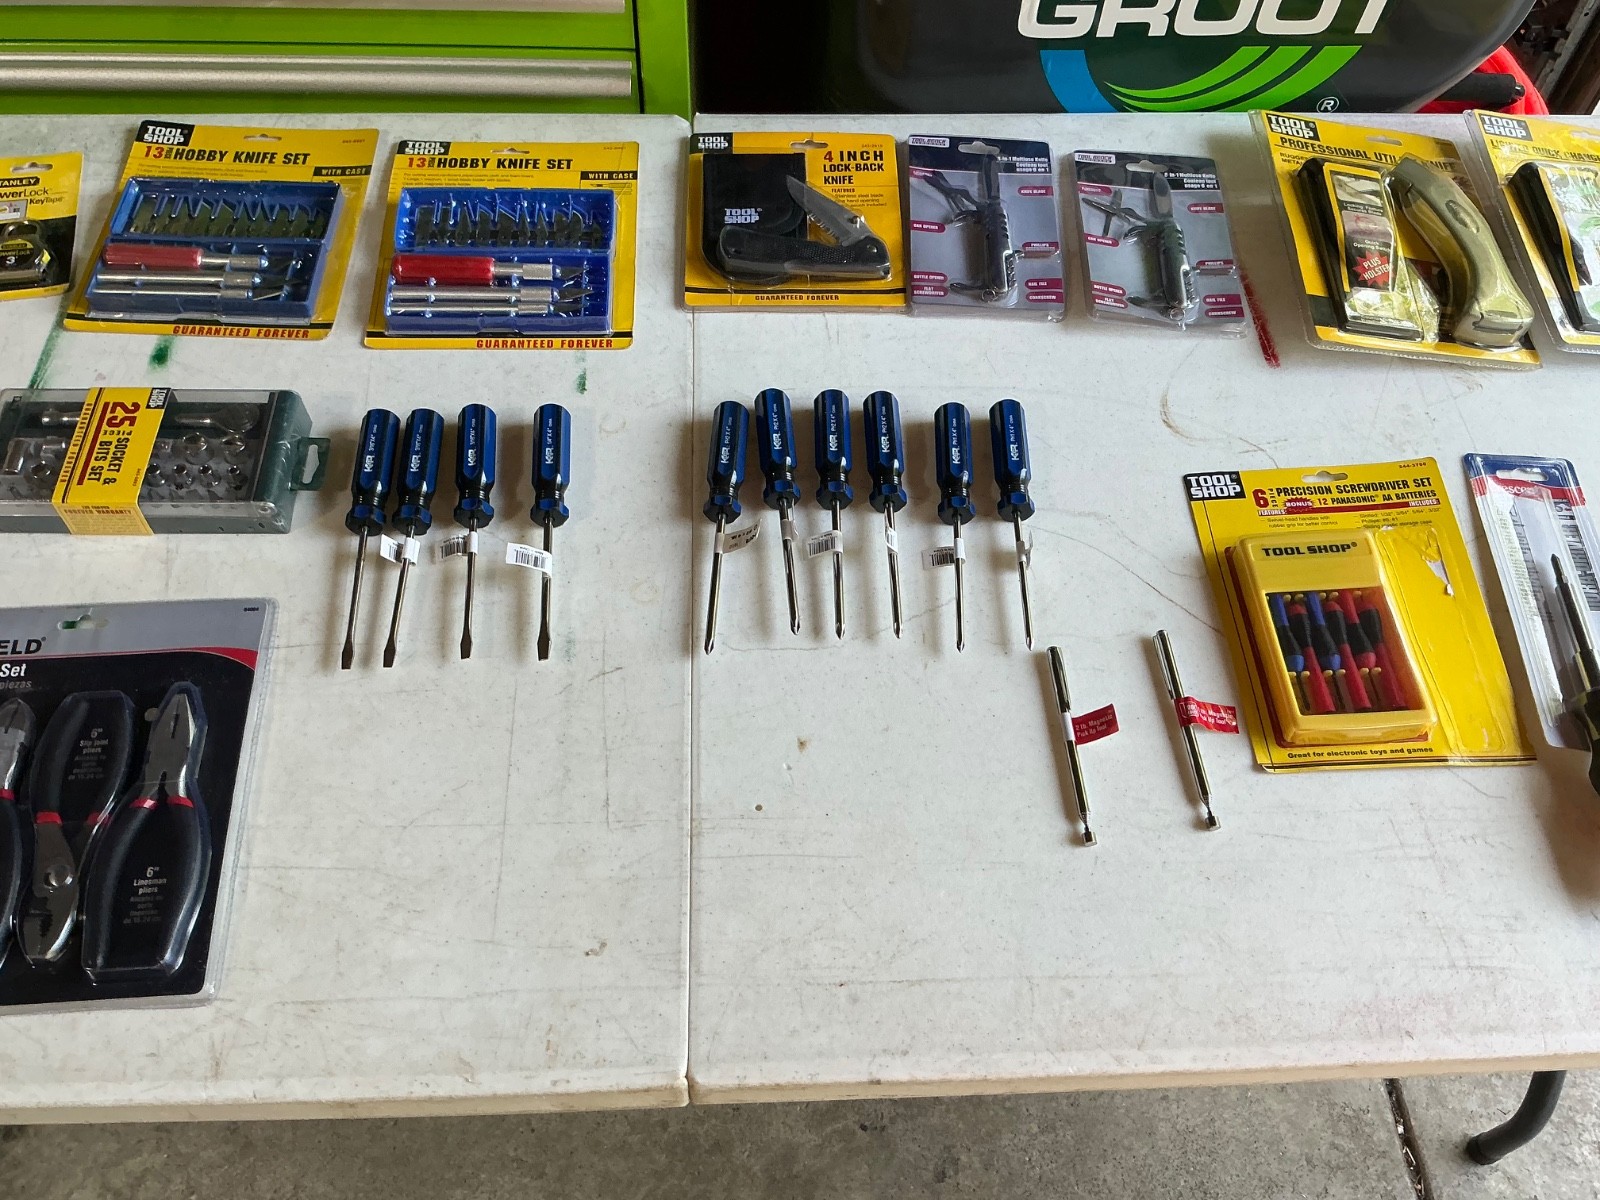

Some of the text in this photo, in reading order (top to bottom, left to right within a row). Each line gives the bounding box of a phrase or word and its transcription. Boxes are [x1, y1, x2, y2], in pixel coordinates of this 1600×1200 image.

[1267, 115, 1310, 131] TOOL
[1481, 115, 1522, 129] TOOL
[146, 126, 182, 136] TOOL
[1270, 123, 1314, 138] SHOP
[1485, 125, 1526, 138] SHOP
[143, 134, 184, 144] SHOP
[1280, 136, 1370, 159] PROFESSIONAL
[144, 146, 164, 159] 13
[174, 148, 228, 162] HOBBY
[233, 151, 276, 164] KNIFE
[282, 153, 310, 165] SET
[824, 151, 883, 162] 4 INCH
[408, 158, 426, 168] 13
[436, 158, 490, 169] HOBBY
[497, 158, 540, 169] KNIFE
[546, 159, 573, 169] SET
[824, 163, 884, 172] LOCK-BACK
[824, 176, 853, 184] KNIFE
[724, 215, 759, 224] SHOP
[1363, 256, 1381, 269] PLUS
[173, 326, 309, 338] GUARANTEED FOREVER
[476, 339, 613, 348] GUARANTEED FOREVER
[148, 389, 157, 407] SHOP
[157, 389, 167, 405] TOOL
[106, 402, 140, 428] 25
[60, 403, 93, 483] GUARANTEED FOREVER
[88, 441, 113, 482] BITS SET
[107, 437, 130, 473] SOCKET
[1187, 474, 1231, 487] TOOL
[1190, 484, 1241, 498] SHOP
[1253, 488, 1270, 508] 6
[1276, 484, 1332, 498] PRECISION
[1336, 479, 1410, 494] SCREWDRIVER
[1413, 477, 1432, 488] SET
[1331, 495, 1375, 504] PANASONIC
[1382, 493, 1393, 501] AA
[1395, 490, 1437, 500] BATTERIES
[1262, 544, 1351, 556] TOOL SHOP
[0, 663, 26, 677] Set
[1089, 715, 1112, 726] Magnetic
[146, 867, 160, 877] 6"
